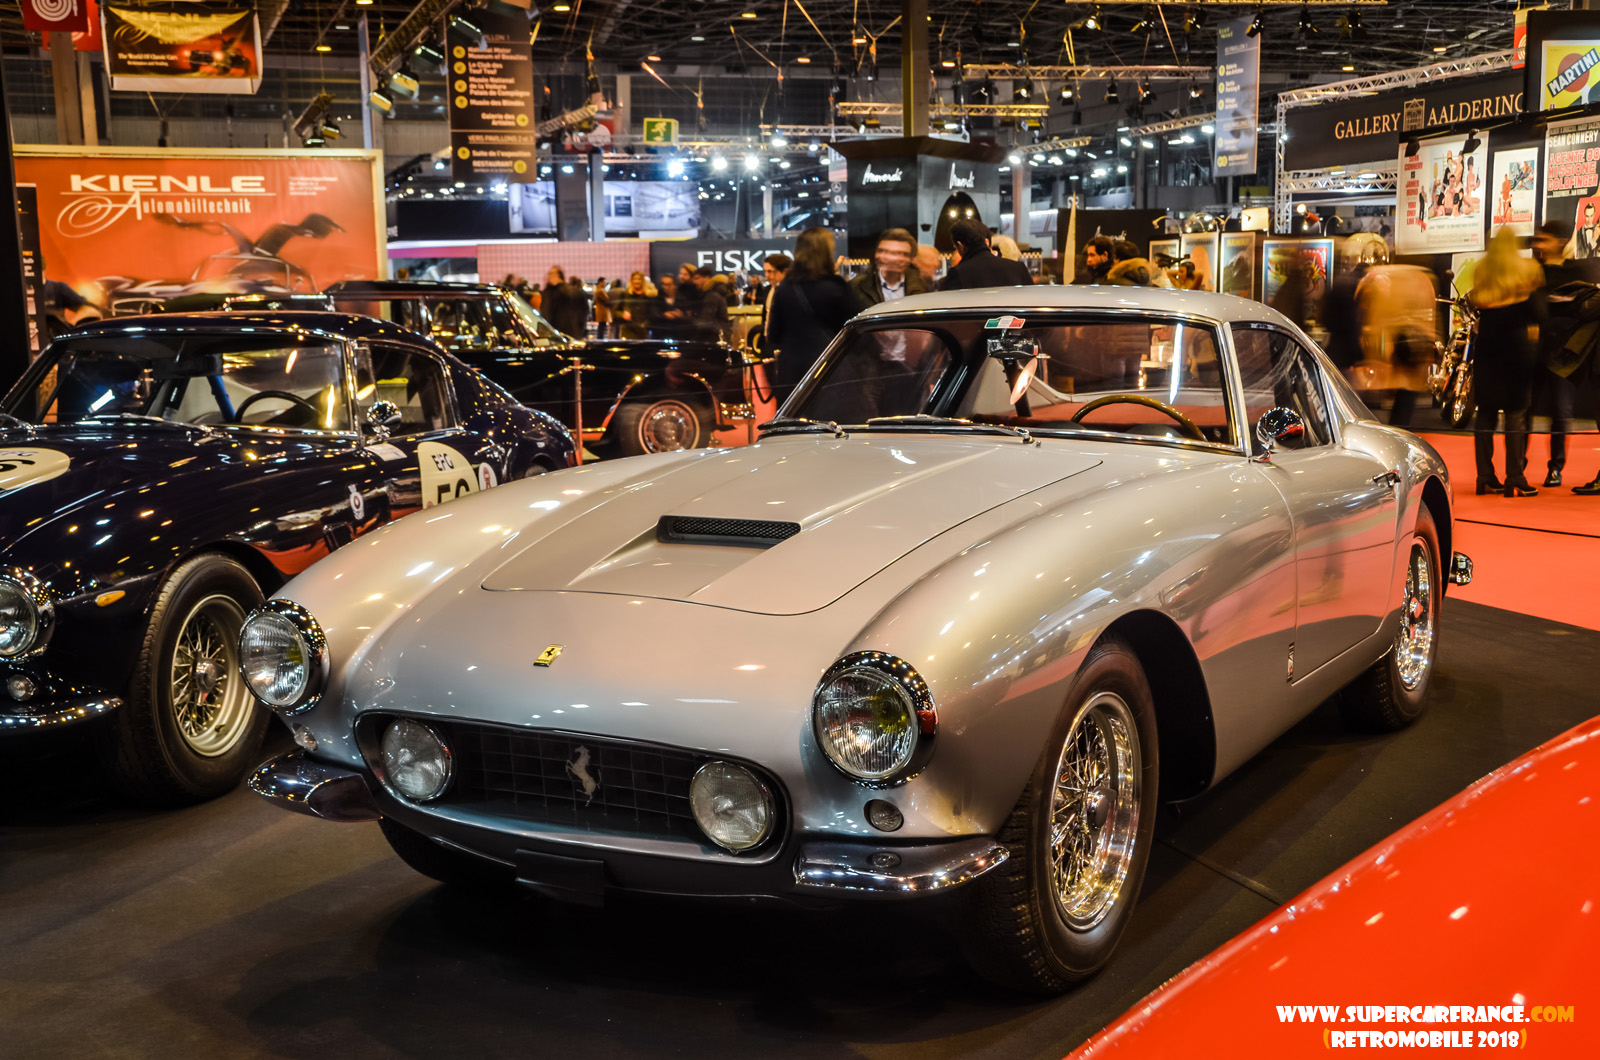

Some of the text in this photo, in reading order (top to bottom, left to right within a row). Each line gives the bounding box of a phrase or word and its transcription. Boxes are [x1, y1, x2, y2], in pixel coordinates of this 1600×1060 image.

[1548, 50, 1599, 96] MARTINI
[1335, 112, 1401, 140] GALLERY
[1549, 130, 1599, 147] SEAN CONNERY
[1549, 149, 1586, 166] AGENTE
[1548, 161, 1597, 178] MISSIONE
[70, 174, 266, 193] KIENLE
[1548, 173, 1599, 191] GOLDFINGER
[697, 250, 795, 271] FISK
